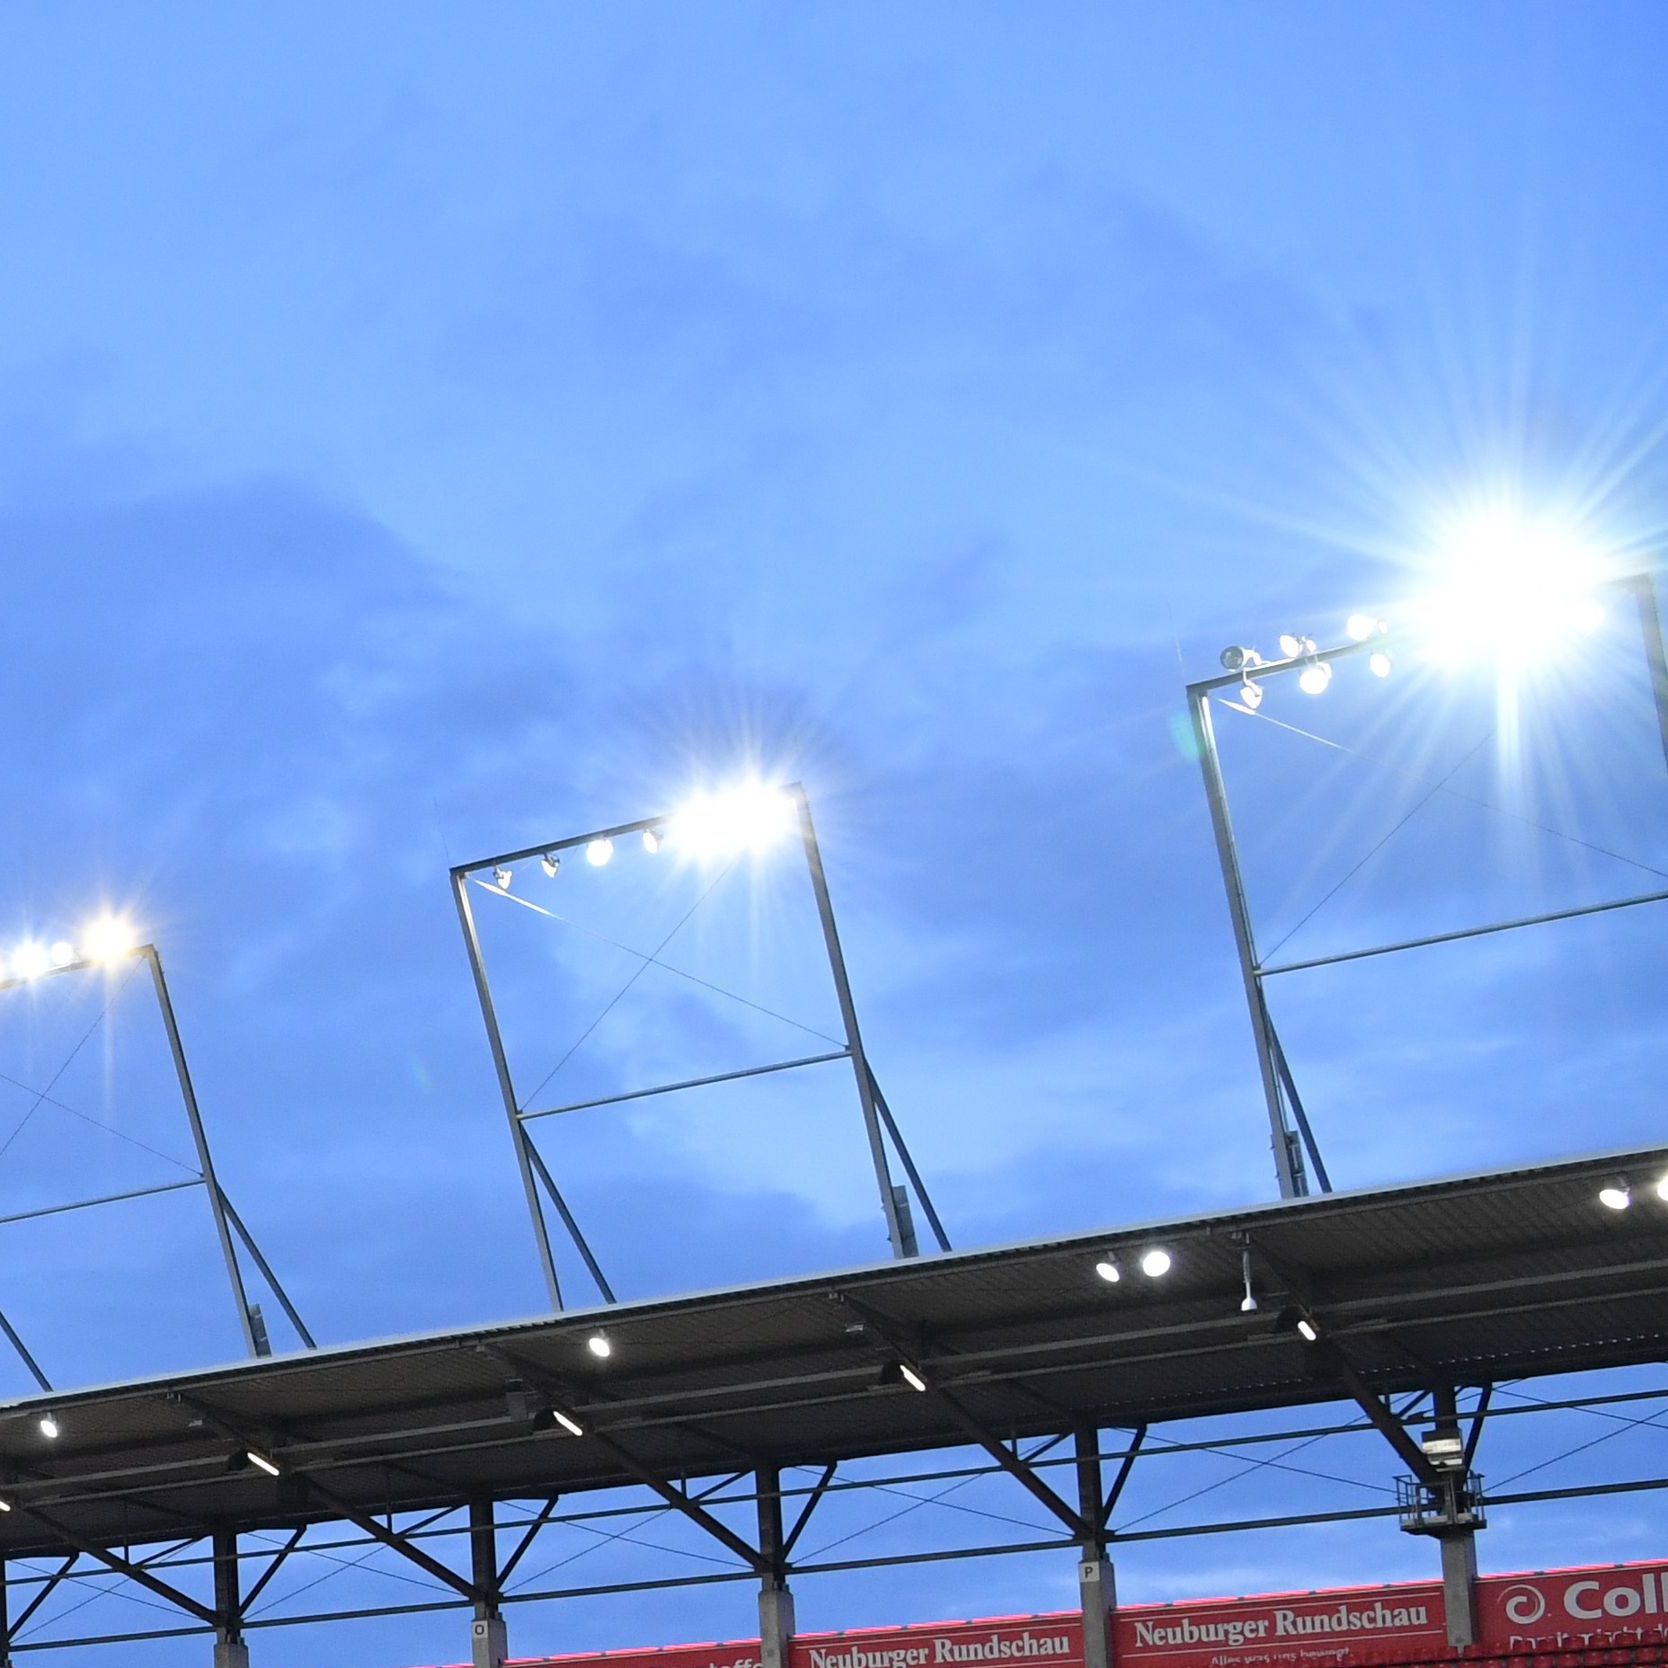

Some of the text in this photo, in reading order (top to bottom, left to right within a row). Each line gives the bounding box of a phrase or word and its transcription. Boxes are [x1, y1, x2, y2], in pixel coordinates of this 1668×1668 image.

[1085, 1566, 1094, 1579] P
[1134, 1602, 1428, 1648] Neuburger Rundschau
[933, 1631, 1070, 1663] Rundschau
